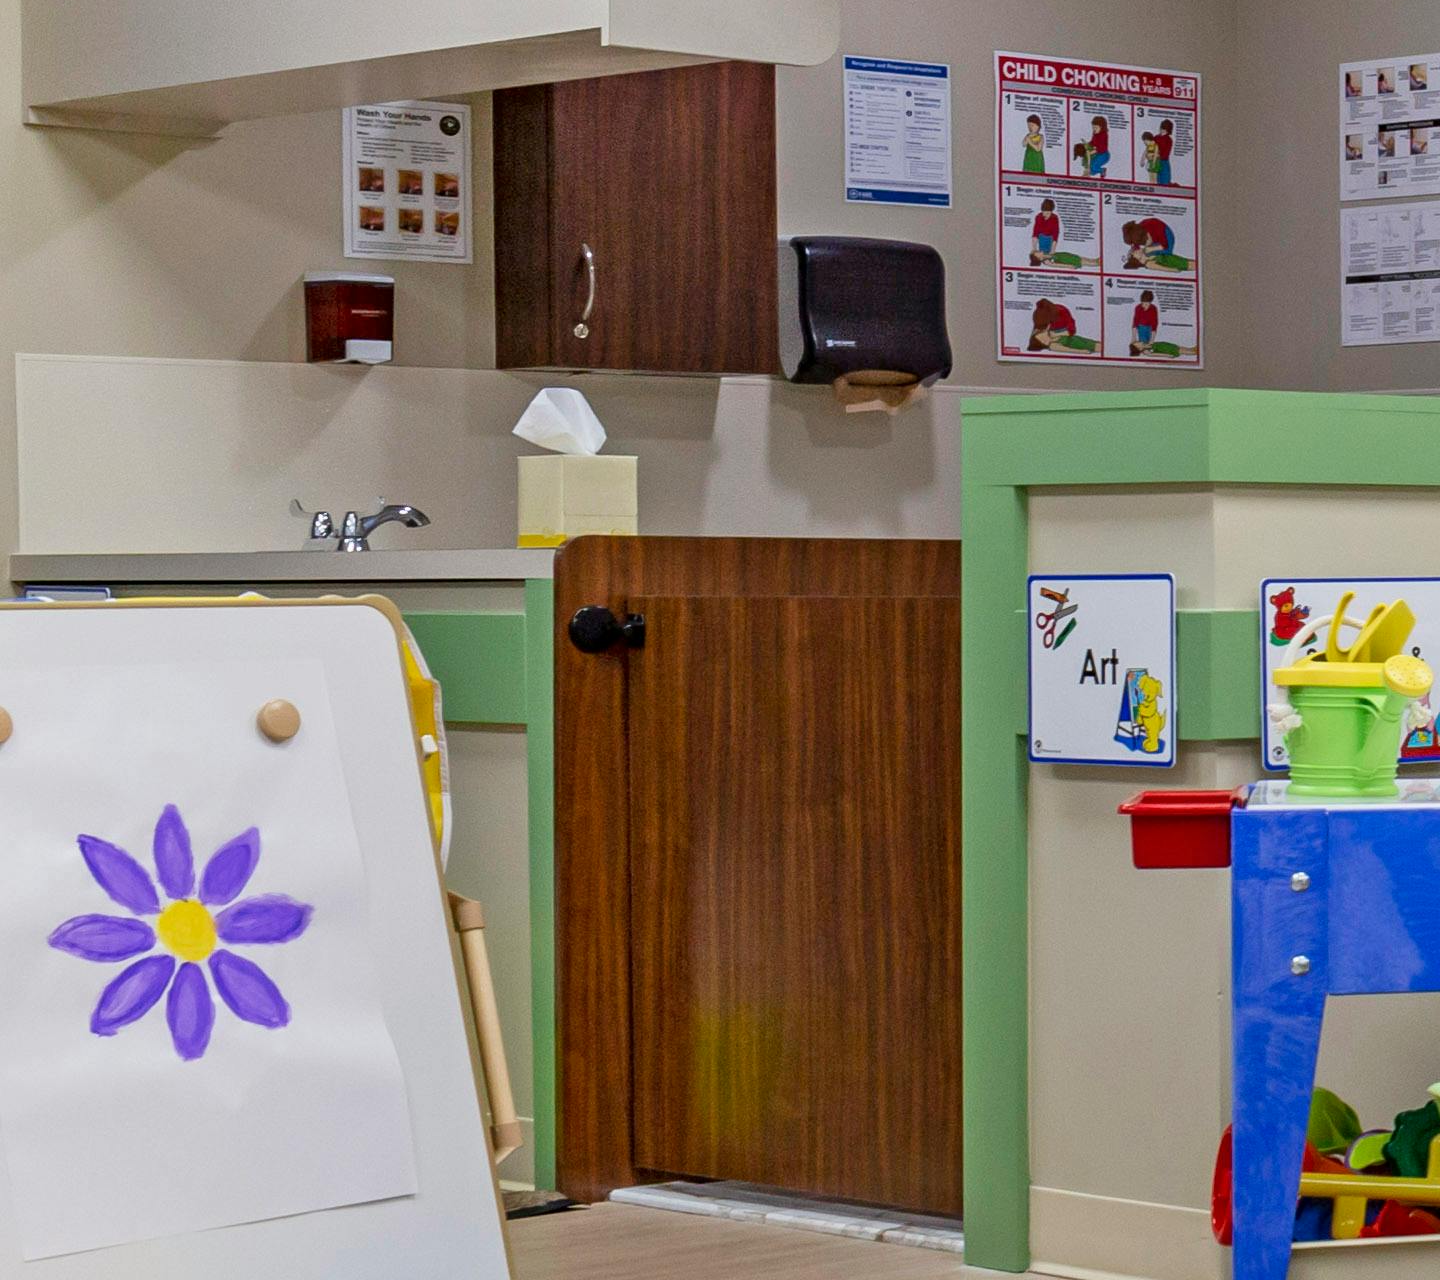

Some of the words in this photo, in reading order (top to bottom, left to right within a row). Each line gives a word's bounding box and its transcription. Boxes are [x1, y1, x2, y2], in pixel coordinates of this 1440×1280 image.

[1003, 61, 1057, 82] CHILD
[1062, 67, 1140, 92] CHOKING
[1142, 85, 1171, 95] YEARS
[1175, 87, 1194, 98] 911
[1005, 94, 1011, 104] 1
[1072, 101, 1080, 111] 2
[357, 109, 380, 117] Wash
[404, 113, 432, 121] Hands
[1137, 107, 1144, 117] 3
[1005, 186, 1011, 196] 1
[1104, 194, 1112, 204] 2
[1005, 272, 1013, 282] 3
[1105, 278, 1113, 288] 4
[1079, 649, 1119, 684] Art
